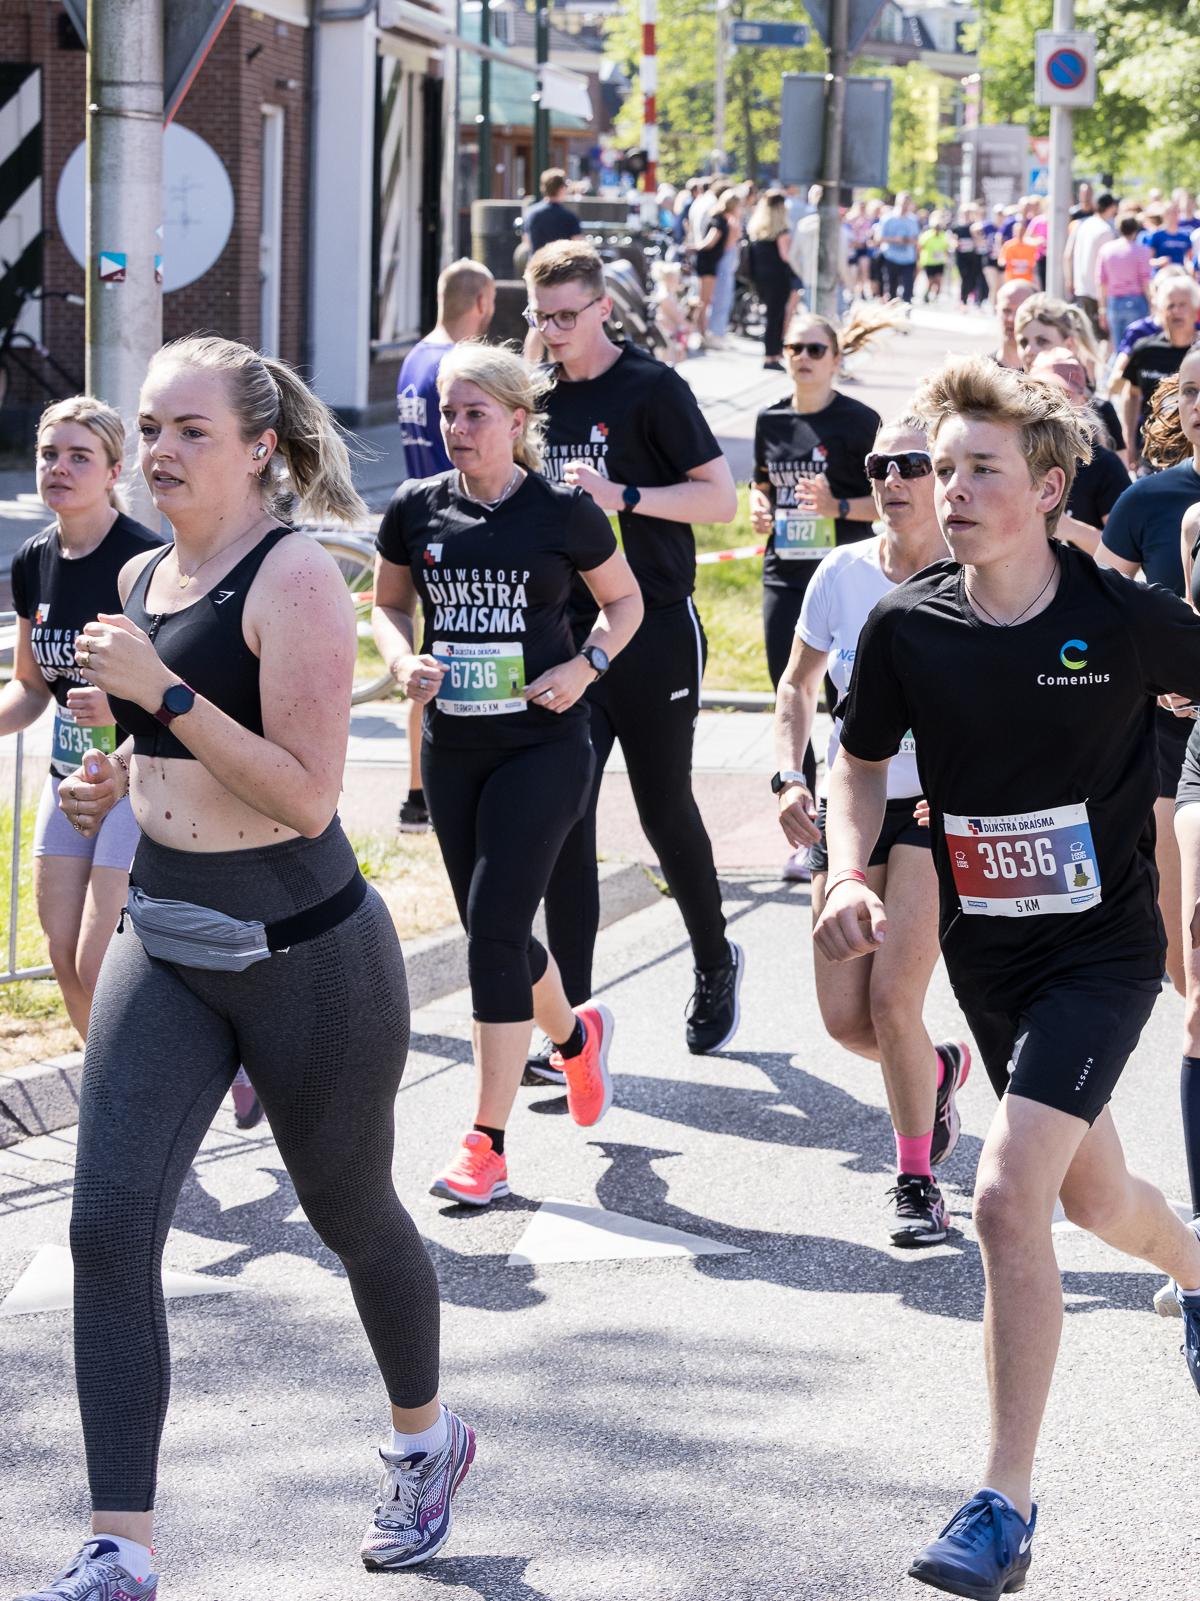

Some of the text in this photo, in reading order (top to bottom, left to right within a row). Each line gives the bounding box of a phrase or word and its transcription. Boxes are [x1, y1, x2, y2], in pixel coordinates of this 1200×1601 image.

[541, 443, 609, 458] OUWGROEP
[786, 520, 817, 541] 6727
[422, 568, 531, 584] BOUWGROEP
[426, 582, 528, 608] DIJKSTRA
[433, 604, 526, 633] DRAISMA
[31, 627, 79, 641] BOUWGR
[450, 661, 498, 689] 6736
[1037, 672, 1110, 686] Comenius
[482, 703, 487, 712] 5
[488, 703, 499, 712] KM
[58, 723, 95, 754] 6735
[904, 741, 909, 751] 5
[983, 816, 1055, 833] DIJKSTRA DRAISMA
[977, 837, 1057, 879] 3636
[1015, 900, 1023, 913] 5
[1024, 898, 1041, 912] KM
[1074, 1057, 1094, 1091] KIPSTA
